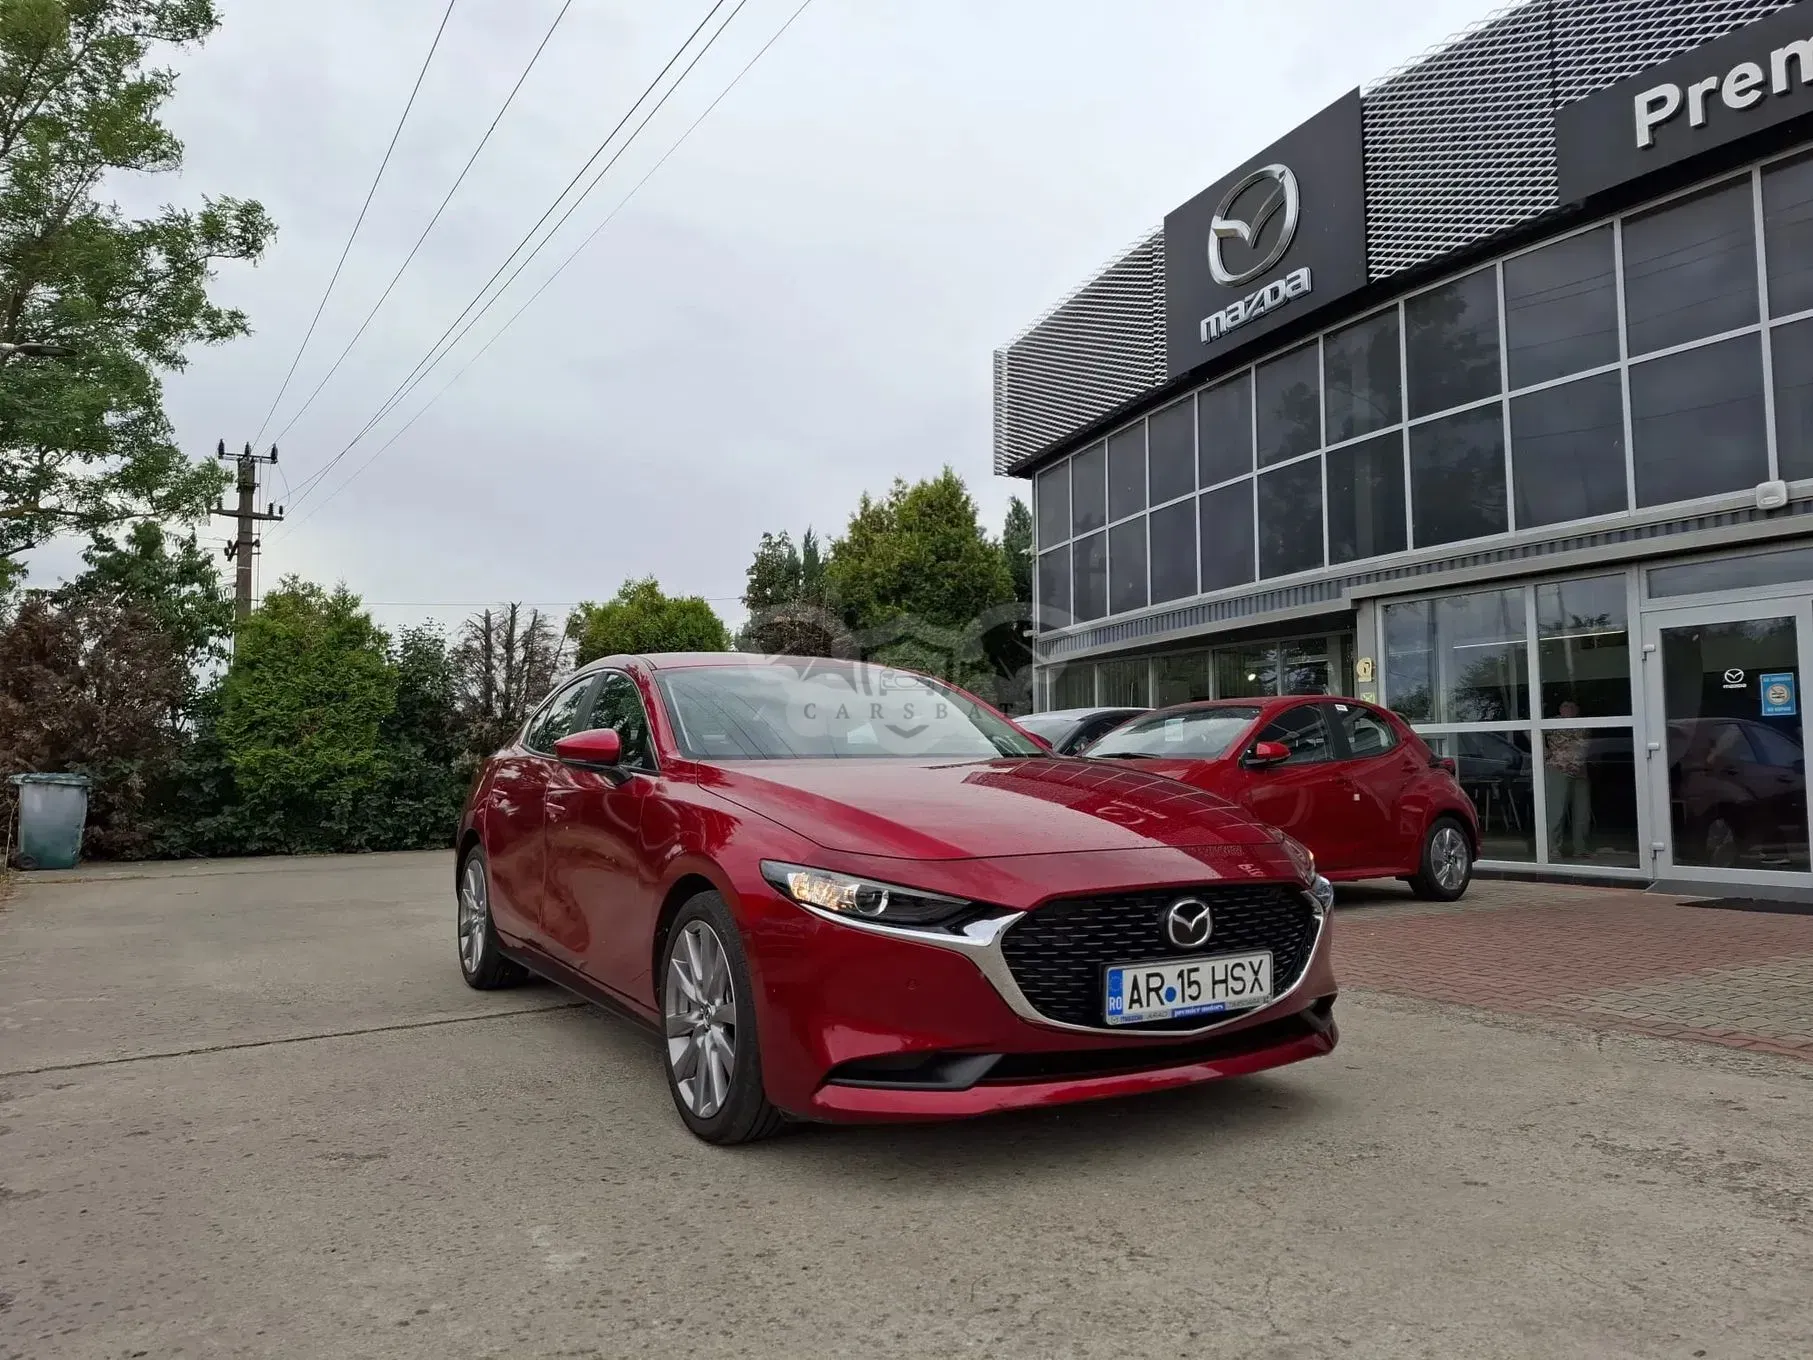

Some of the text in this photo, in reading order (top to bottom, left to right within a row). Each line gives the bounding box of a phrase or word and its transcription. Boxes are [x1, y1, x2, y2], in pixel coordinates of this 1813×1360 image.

[1200, 266, 1312, 344] mazda
[1109, 996, 1122, 1011] RO
[1128, 959, 1264, 1010] AR 15 HSX
